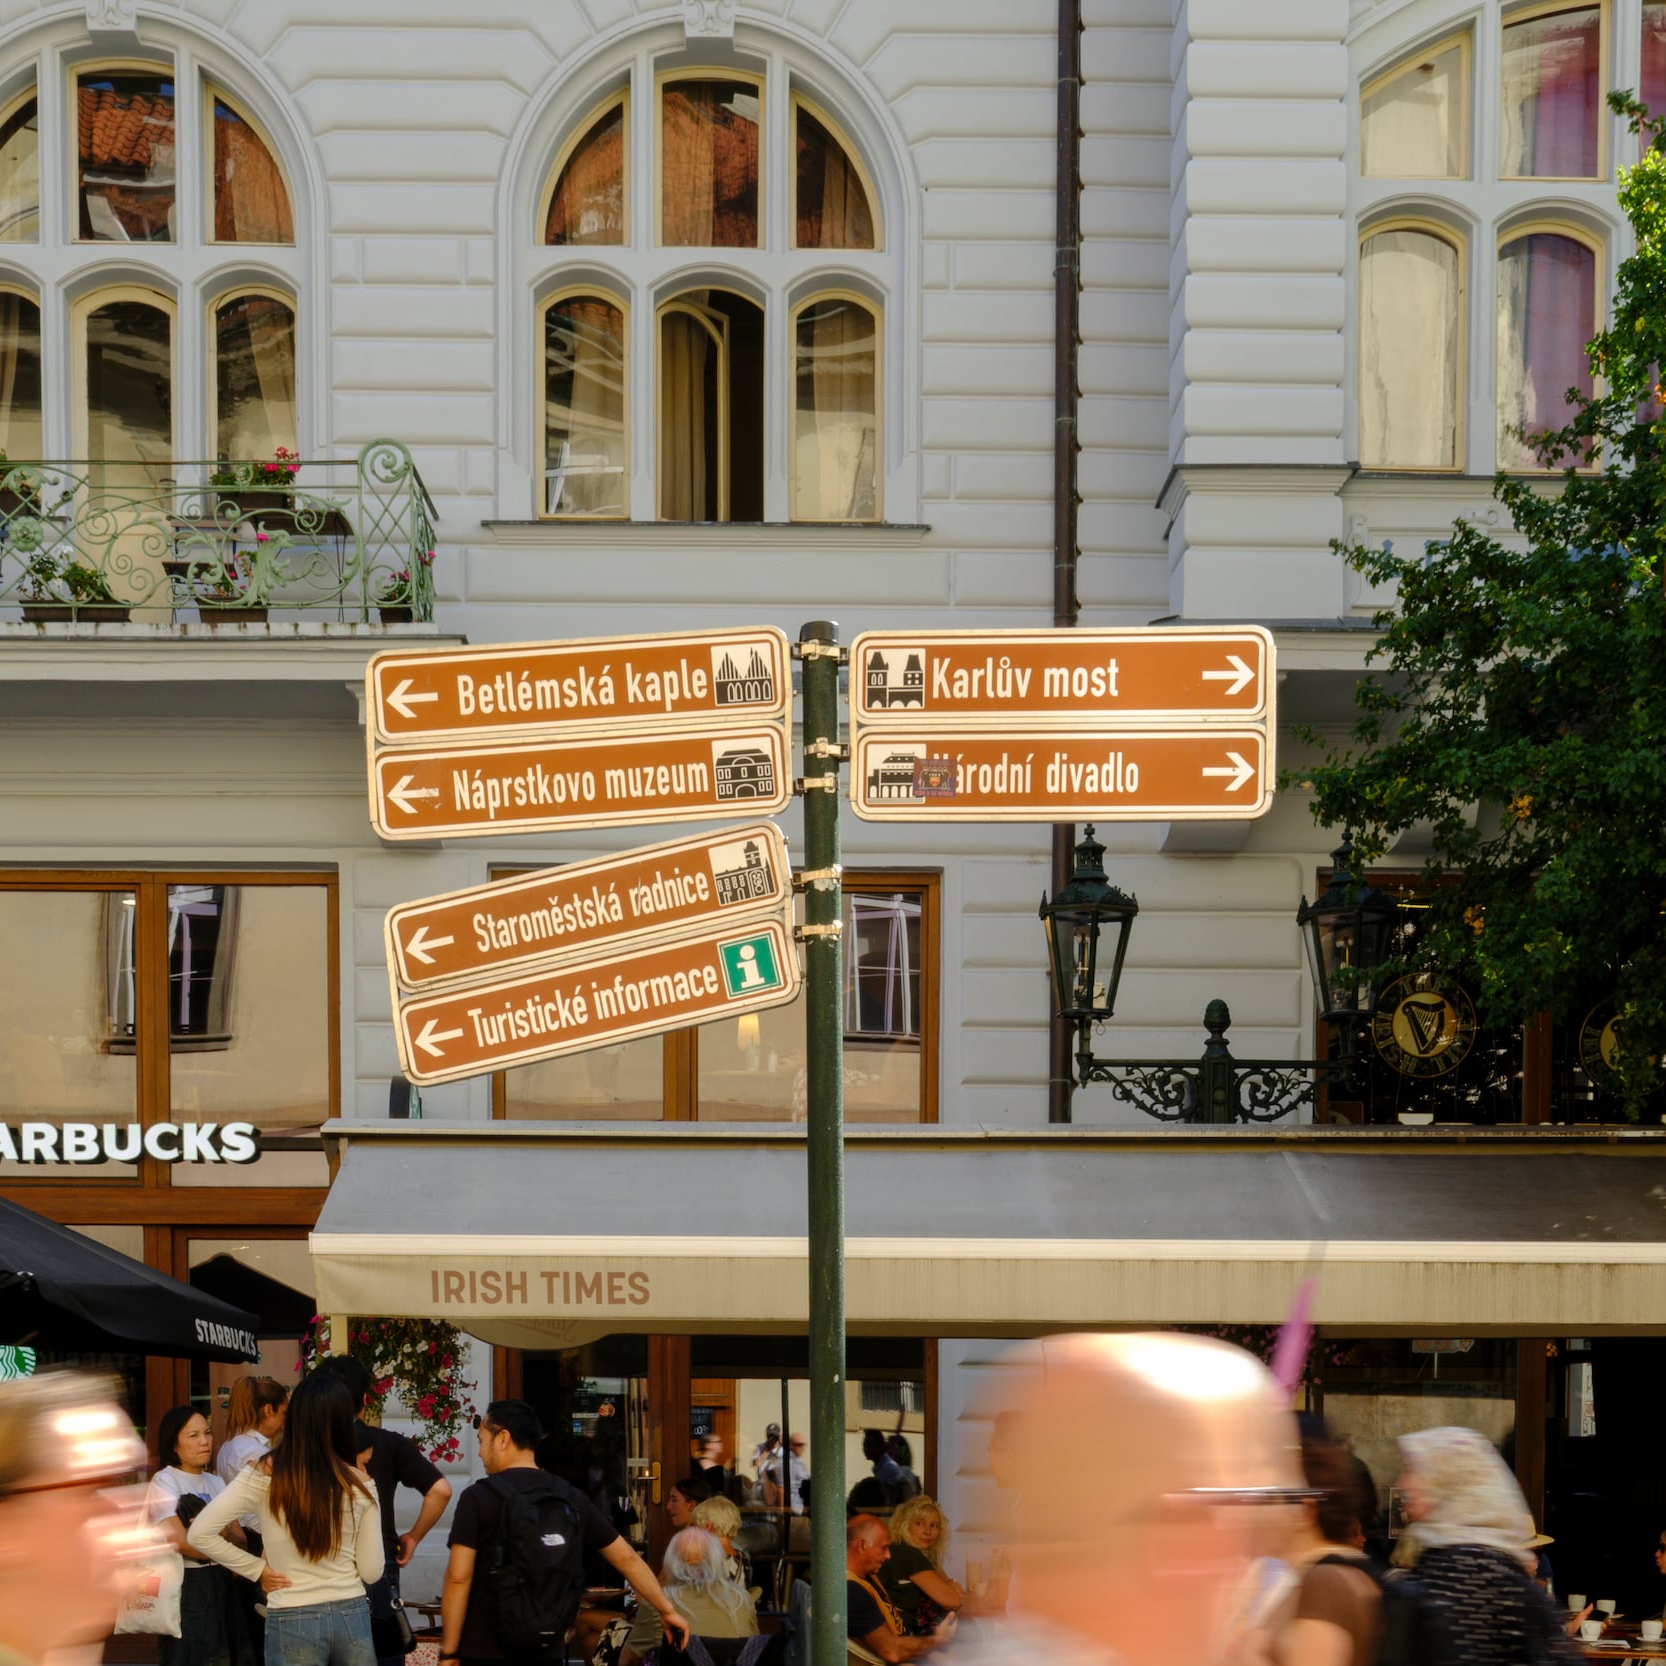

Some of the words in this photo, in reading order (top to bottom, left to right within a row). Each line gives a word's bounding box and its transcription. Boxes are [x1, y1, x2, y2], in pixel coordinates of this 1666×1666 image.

[457, 664, 615, 716] Betlémská
[626, 659, 708, 712] kaple
[933, 656, 1032, 699] Karlův
[1043, 660, 1120, 698] most
[453, 763, 595, 819] Náprstkovo
[604, 761, 709, 800] muzeum
[933, 753, 1035, 794] árodní
[1047, 752, 1140, 794] divadlo
[472, 882, 623, 953] Staroměstská
[628, 868, 710, 917] radnice
[468, 984, 588, 1048] Turistické
[592, 963, 719, 1021] informace
[431, 1270, 528, 1304] IRISH
[540, 1271, 651, 1305] TIMES
[195, 1318, 258, 1357] STARBUCKS
